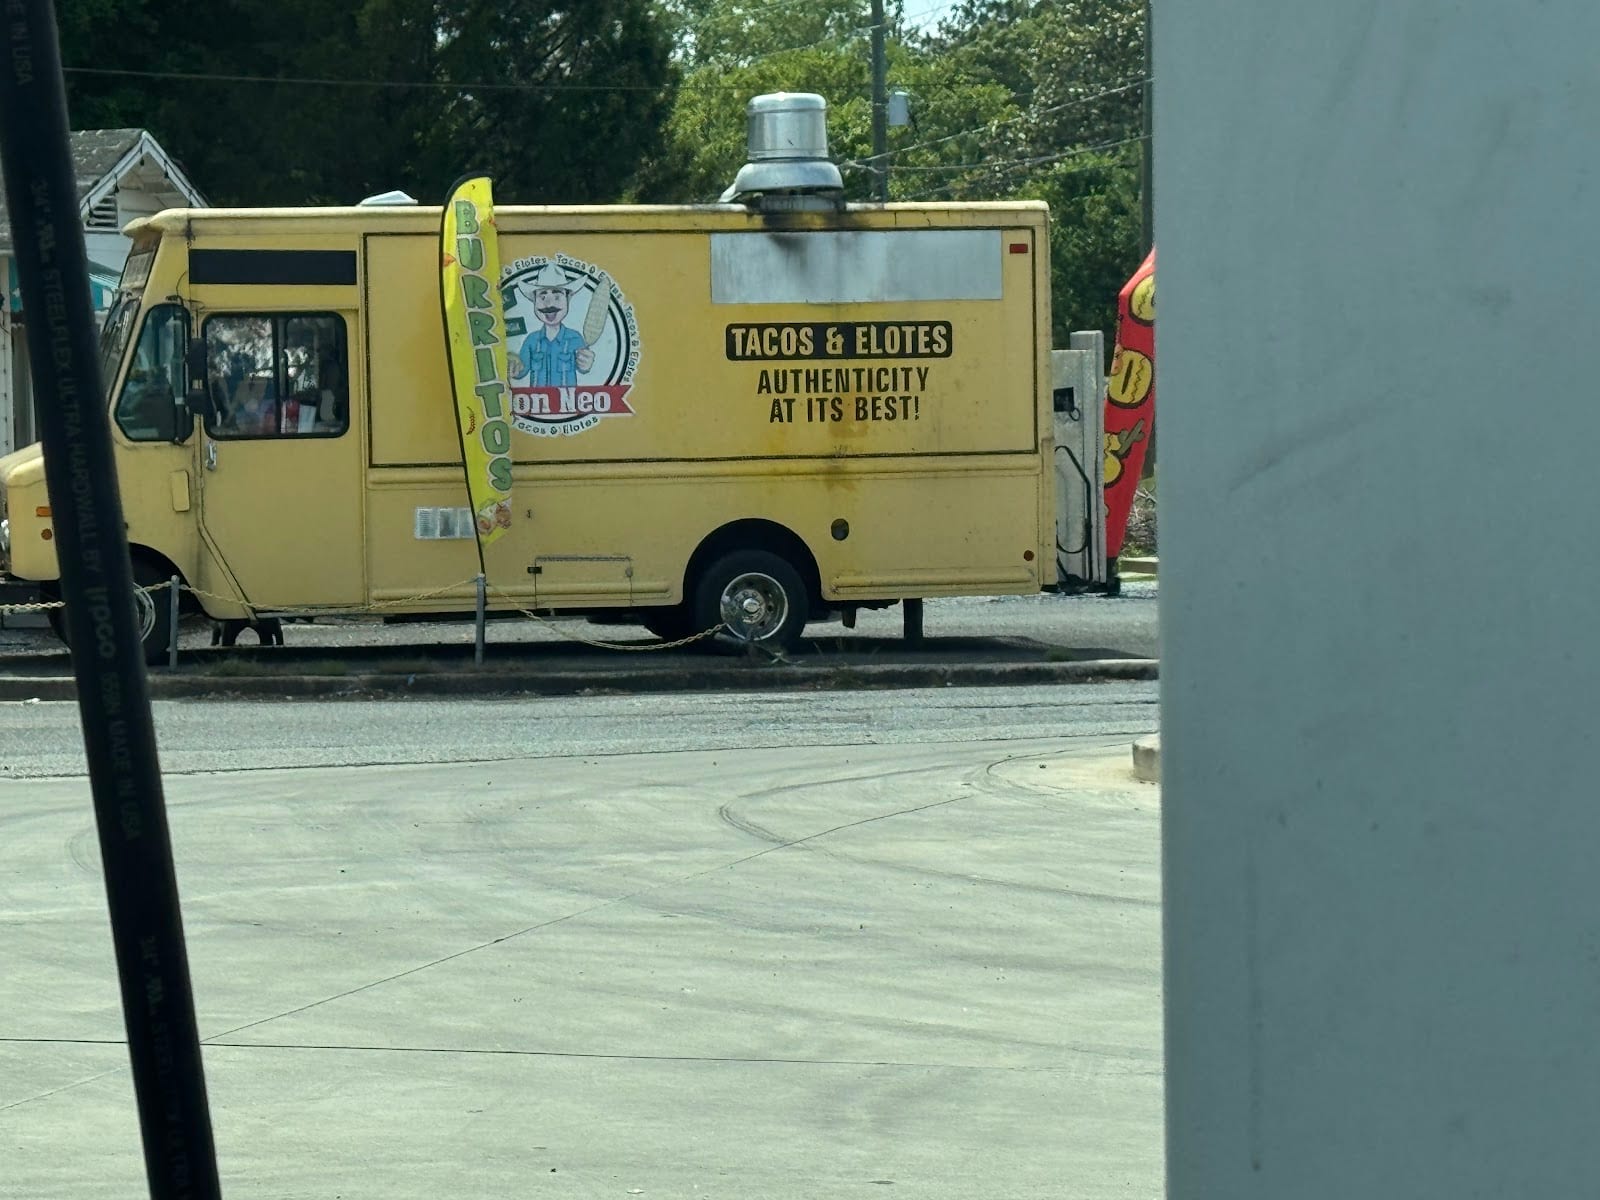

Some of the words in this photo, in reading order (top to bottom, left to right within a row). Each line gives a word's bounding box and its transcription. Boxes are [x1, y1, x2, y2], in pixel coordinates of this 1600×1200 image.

[12, 46, 35, 87] USA
[515, 257, 548, 270] Elotes
[556, 254, 586, 270] Tacos
[42, 270, 73, 374] STEELFLEX
[455, 200, 513, 491] BURRITOS
[731, 327, 814, 356] TACOS
[825, 327, 845, 355] &
[855, 325, 948, 354] ELOTES
[757, 367, 930, 394] AUTHENTICITY
[57, 377, 83, 437] ULTRA
[512, 392, 551, 414] on
[558, 387, 612, 413] Neo
[769, 398, 796, 423] AT
[807, 397, 844, 423] ITS
[855, 396, 920, 421] BEST!
[562, 415, 599, 434] Elotes
[67, 443, 100, 544] HARDWALL
[109, 719, 132, 772] MADE
[120, 801, 142, 841] USA
